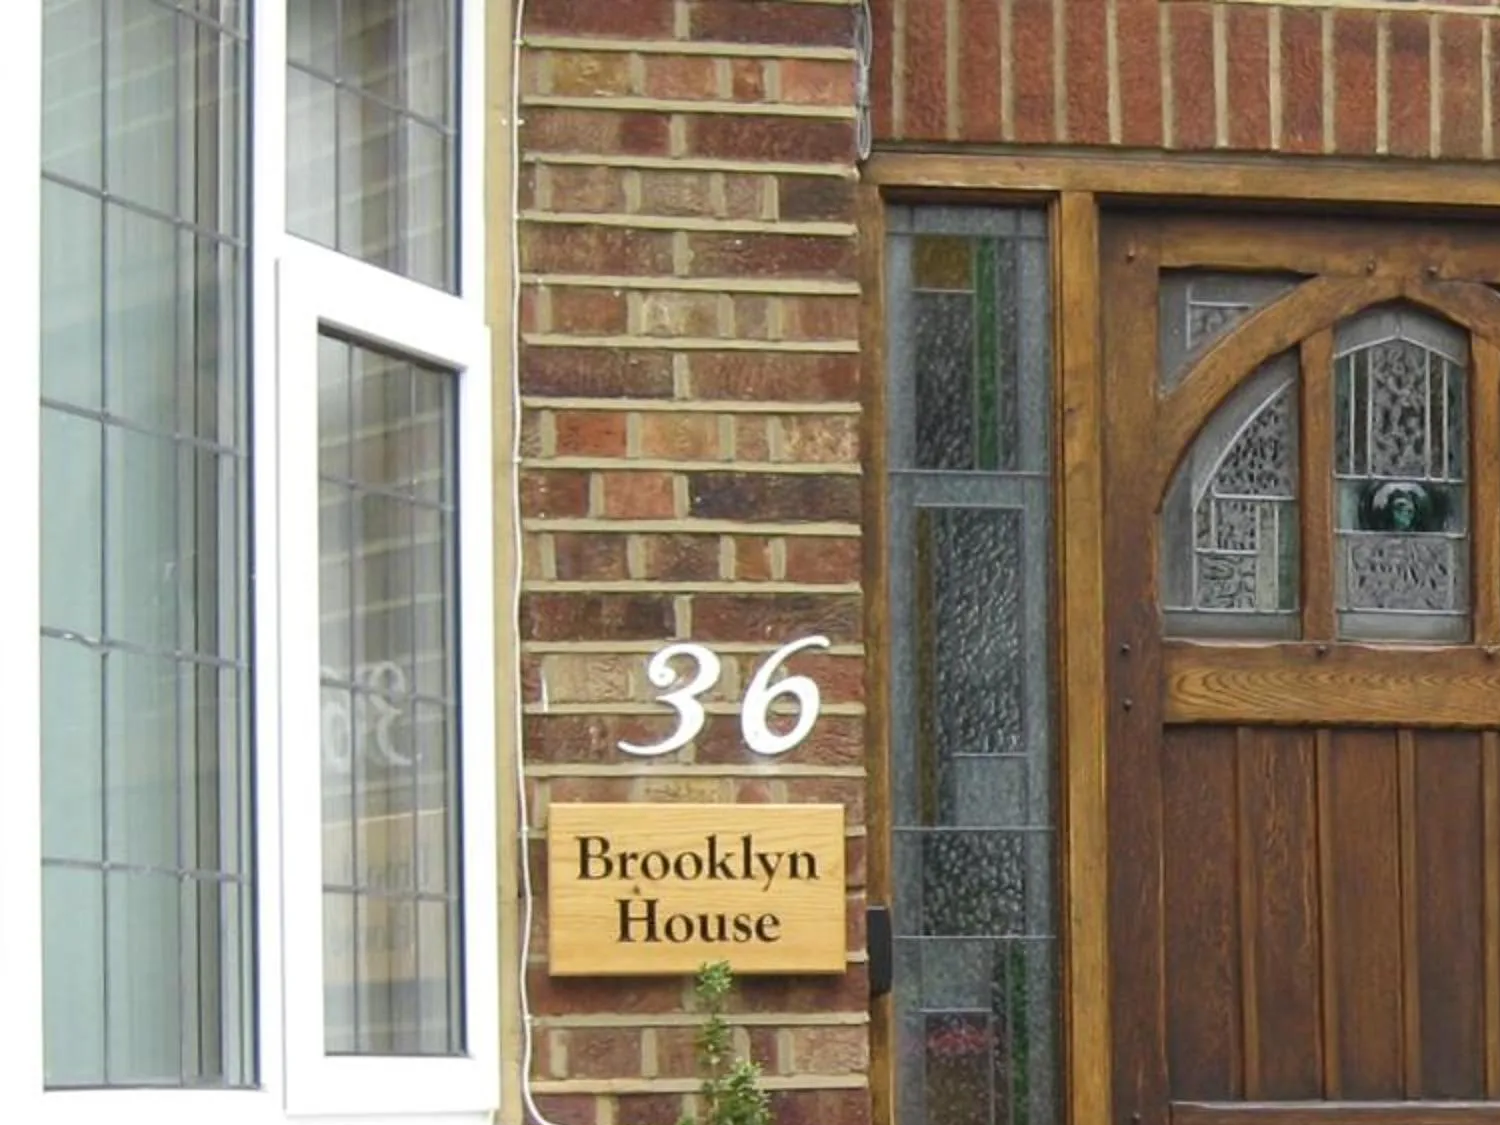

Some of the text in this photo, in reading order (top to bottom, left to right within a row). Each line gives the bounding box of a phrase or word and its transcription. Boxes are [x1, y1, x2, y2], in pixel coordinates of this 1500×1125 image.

[617, 635, 830, 755] 36
[576, 834, 820, 892] Brooklyn
[616, 898, 780, 943] House
